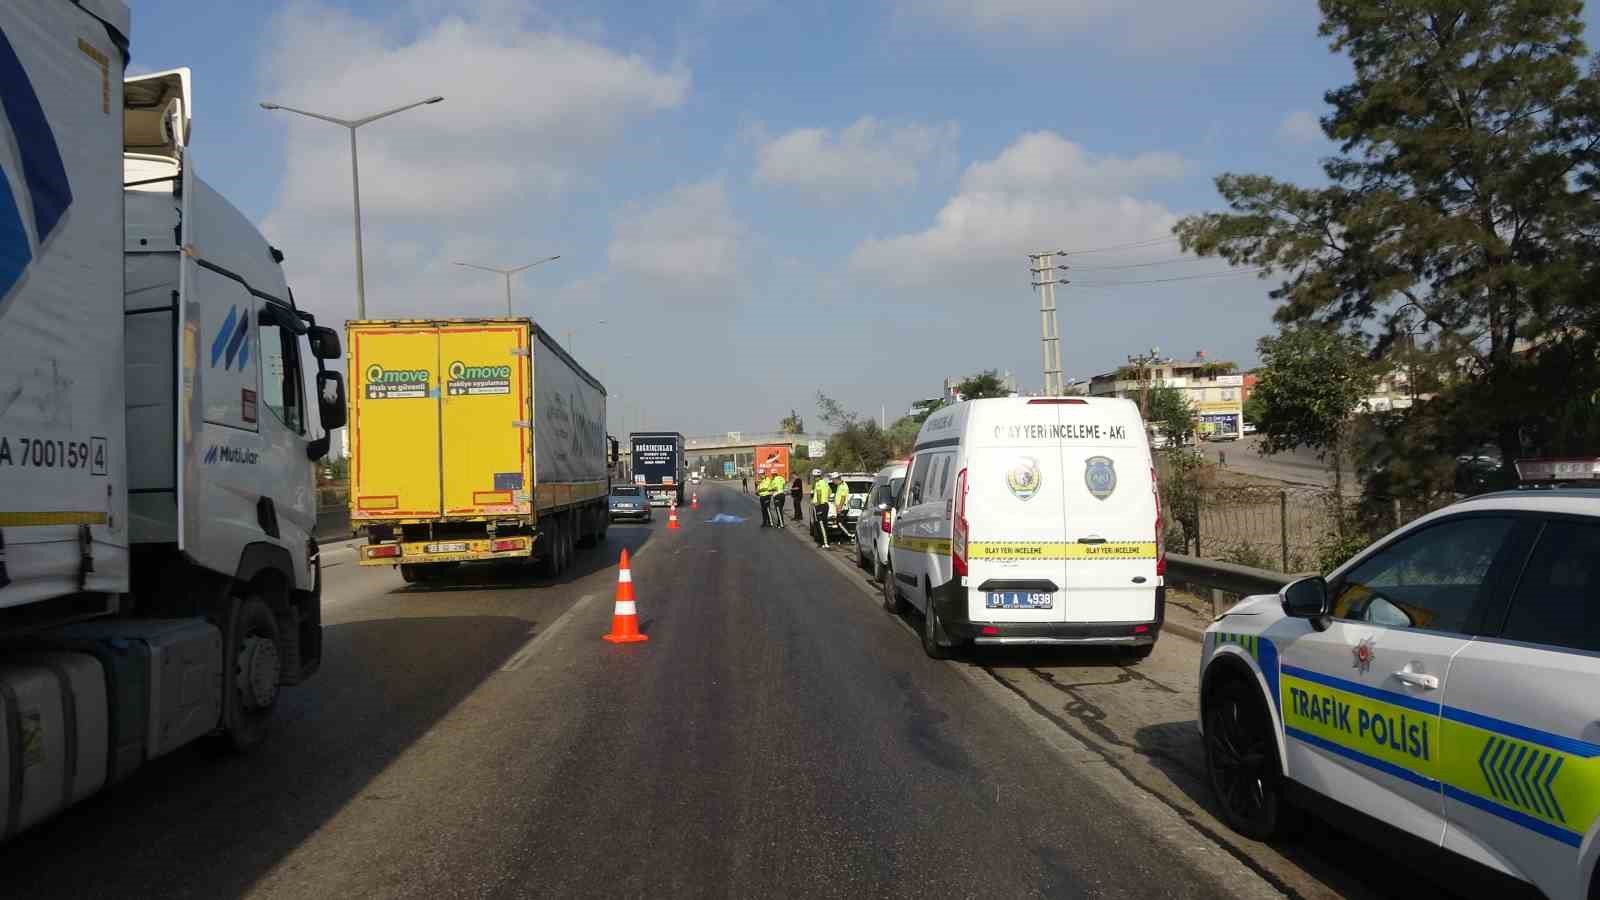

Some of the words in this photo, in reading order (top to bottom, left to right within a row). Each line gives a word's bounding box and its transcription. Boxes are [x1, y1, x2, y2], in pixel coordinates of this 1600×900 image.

[368, 365, 429, 384] Qmove
[450, 362, 510, 380] Qmove
[19, 438, 88, 468] 700159
[95, 444, 104, 468] 4
[993, 593, 1005, 604] 01
[1013, 593, 1019, 604] A
[1290, 687, 1352, 734] TRAFİK
[1358, 706, 1429, 761] POLİSİ
